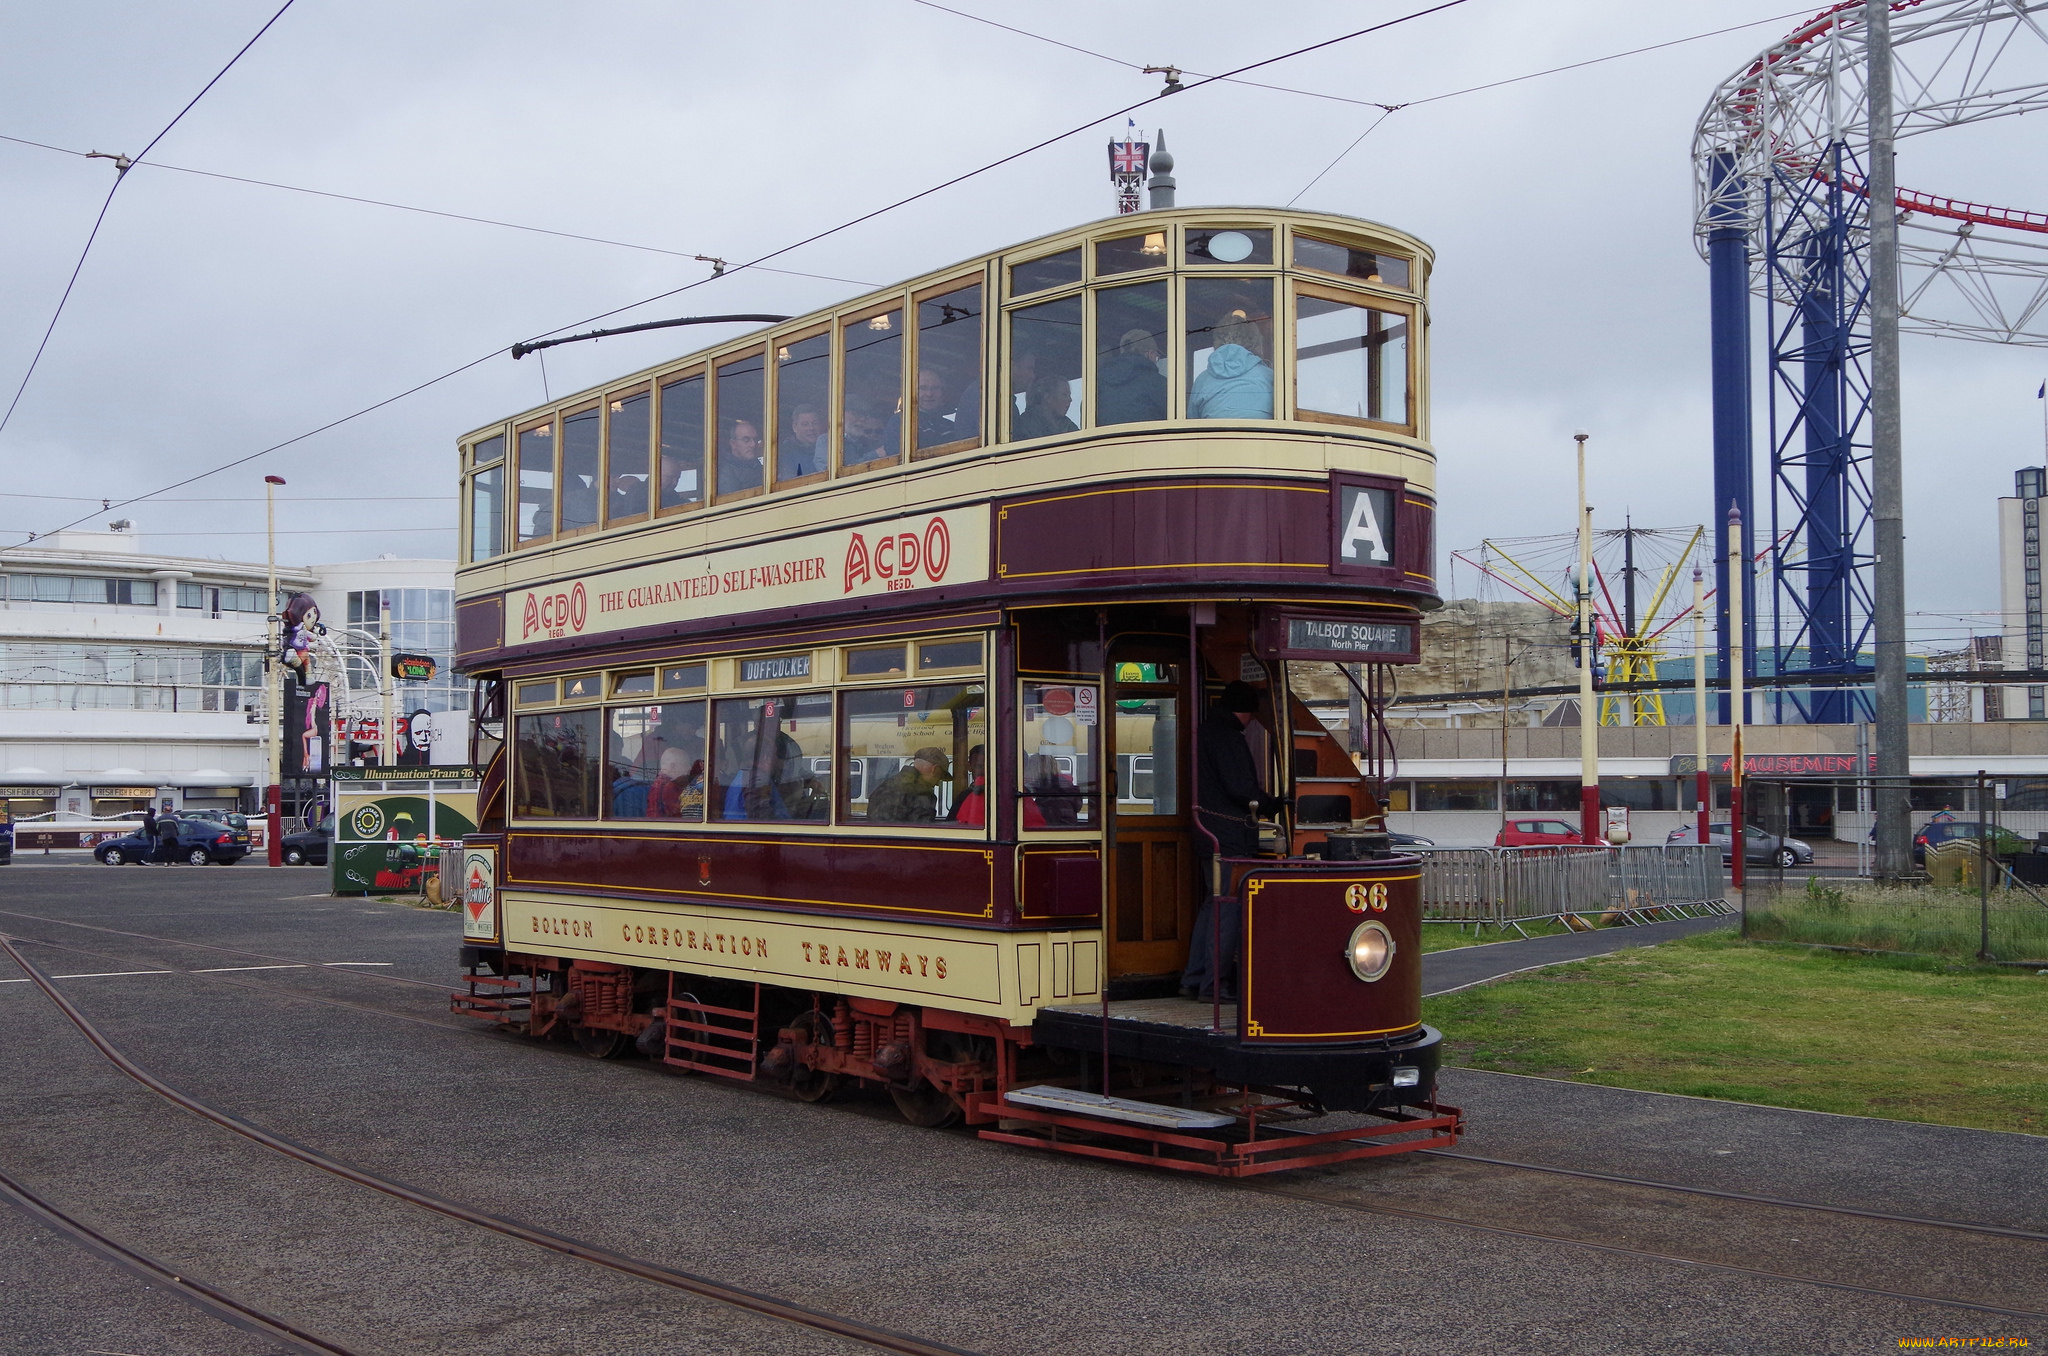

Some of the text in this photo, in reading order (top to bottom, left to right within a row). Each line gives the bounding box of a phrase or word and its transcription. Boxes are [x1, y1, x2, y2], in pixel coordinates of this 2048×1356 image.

[1341, 492, 1389, 561] A
[843, 516, 951, 594] ACDO
[599, 557, 826, 613] THE GUARANTEED SELF-WASHER
[523, 581, 587, 640] ACDO
[1305, 621, 1397, 642] TALBOT SQUARE
[1331, 640, 1370, 650] North Pier
[747, 656, 809, 680] DOFFCOCKER
[364, 769, 432, 779] Illumination
[430, 768, 459, 779] Tram
[1345, 882, 1388, 913] 66
[531, 916, 948, 979] BOLTON CORPORATION TRAMWAYS
